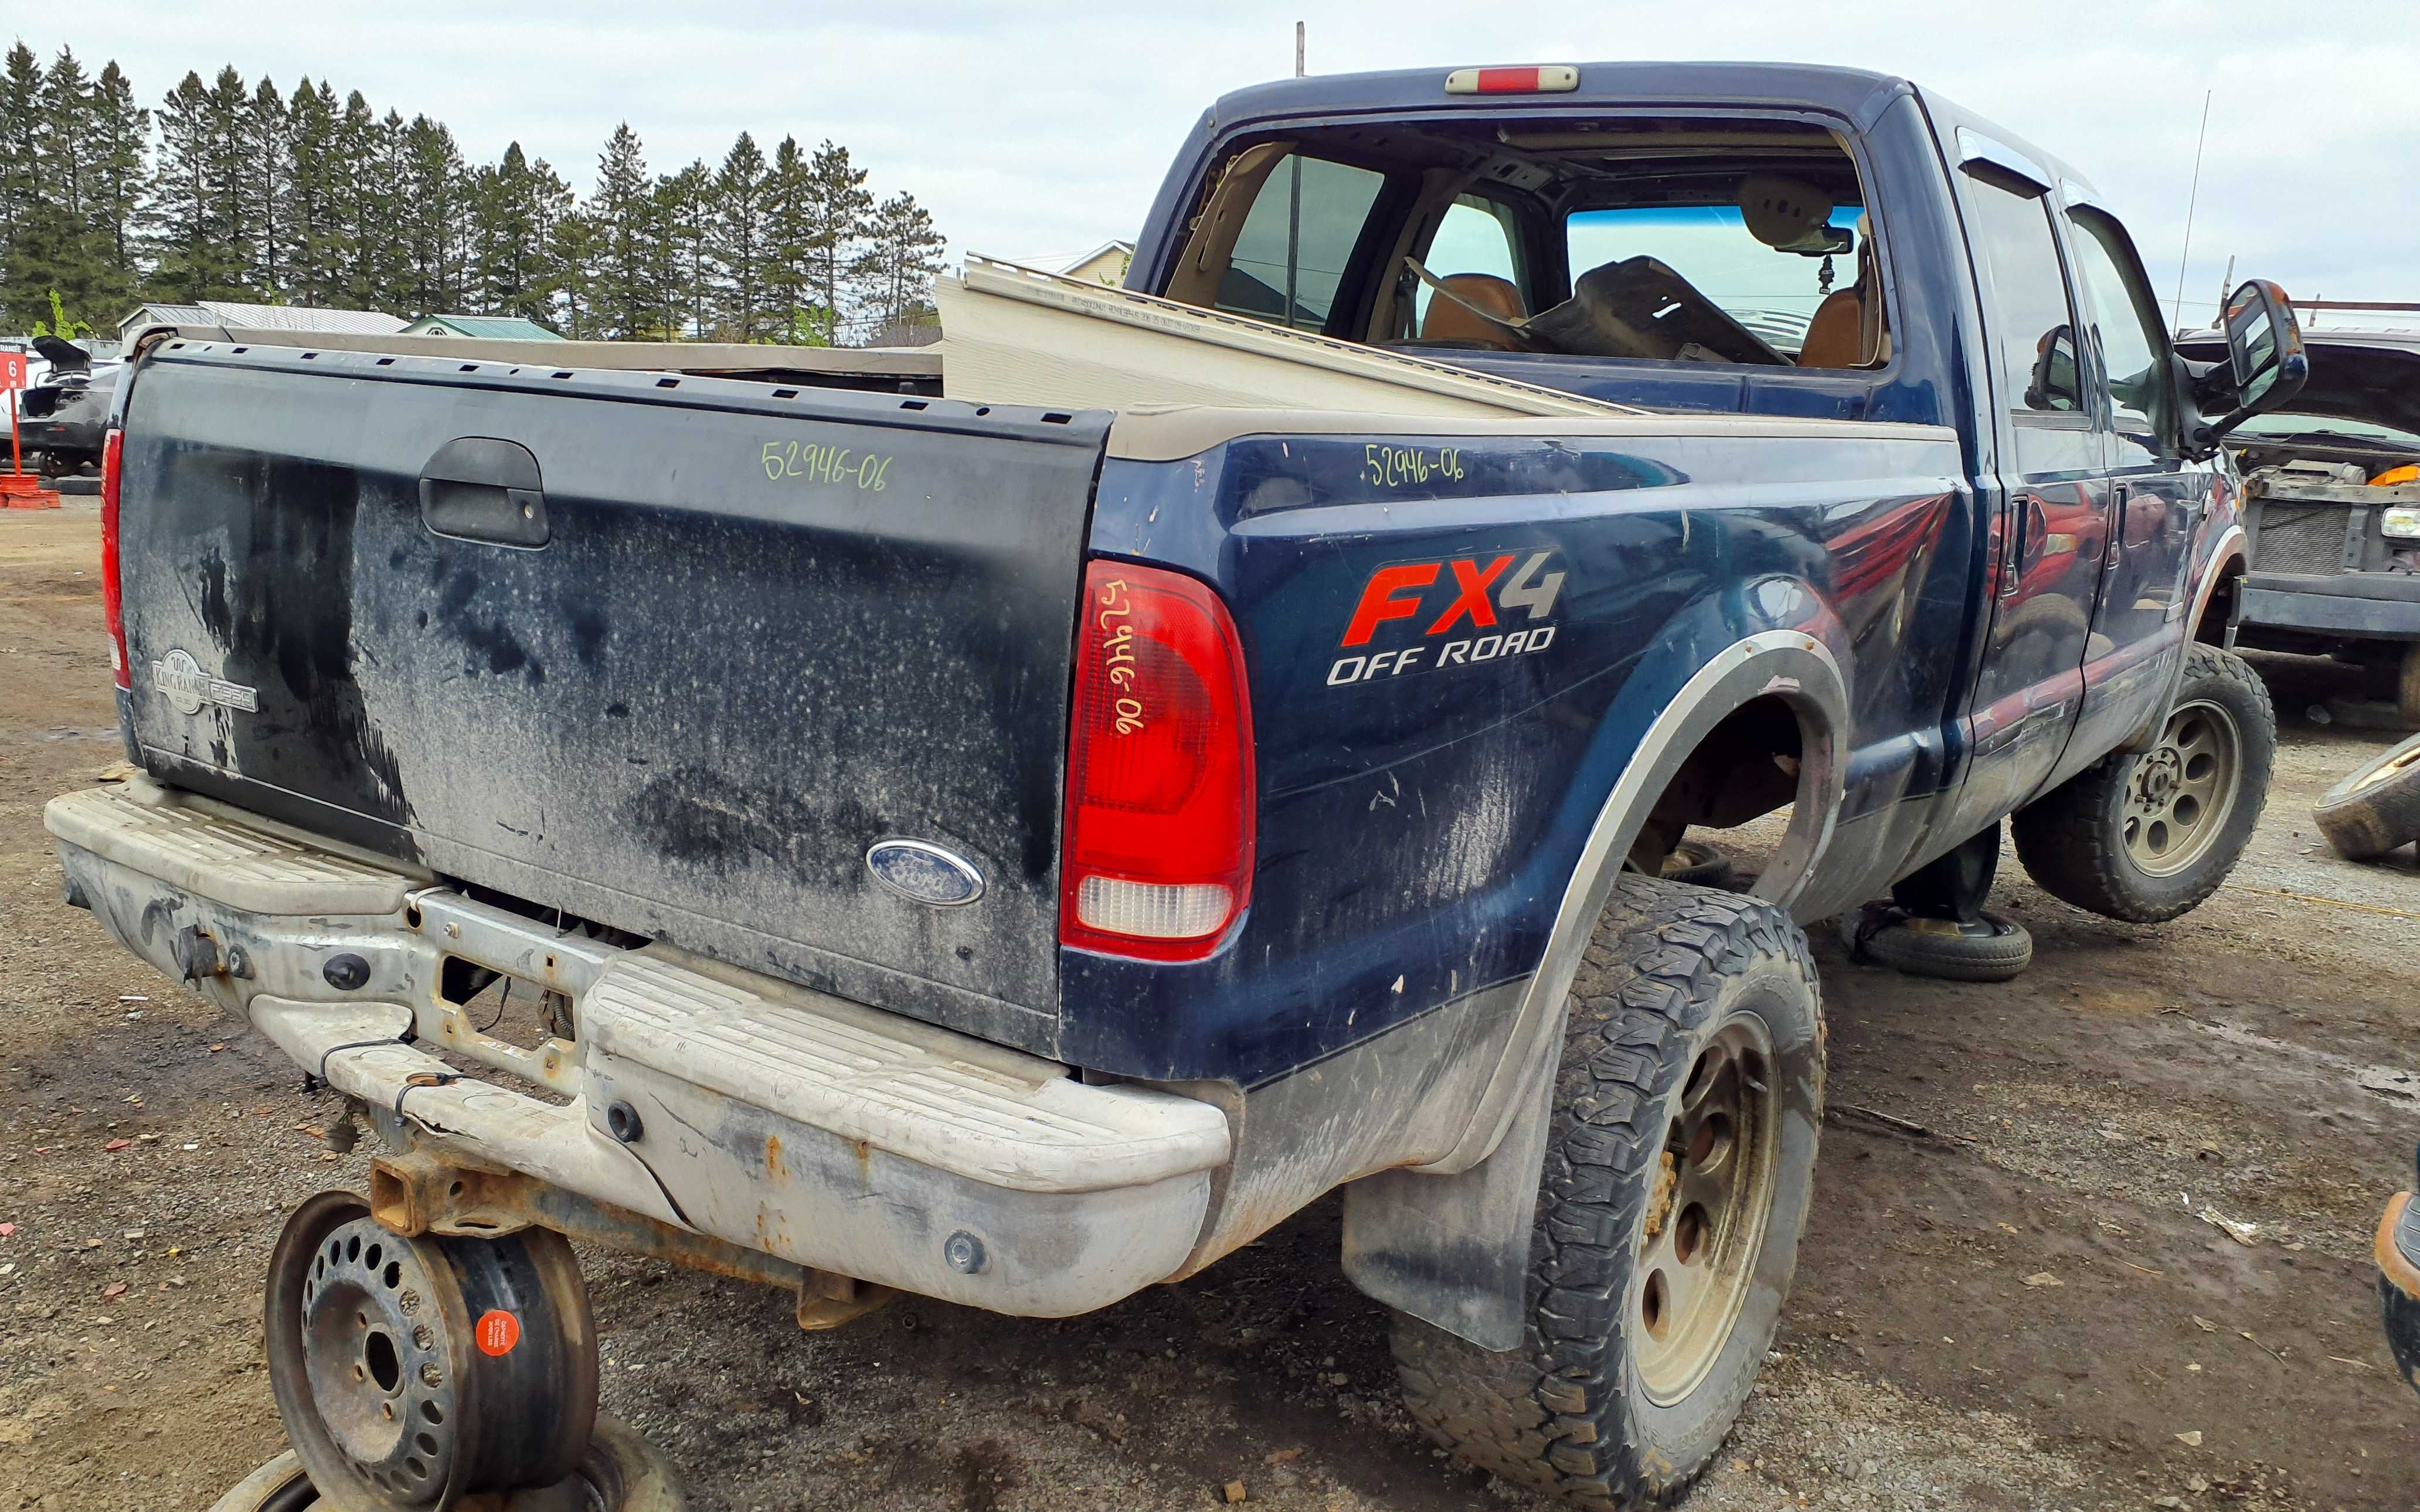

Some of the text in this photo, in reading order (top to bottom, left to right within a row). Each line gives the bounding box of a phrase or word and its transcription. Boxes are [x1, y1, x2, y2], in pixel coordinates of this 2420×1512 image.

[8, 360, 17, 377] 6
[762, 440, 893, 492] 52946-06
[1365, 444, 1464, 487] 52946-06
[1341, 552, 1565, 647] FX4
[1100, 578, 1144, 735] 52946-06
[1326, 626, 1556, 686] OFF ROAD
